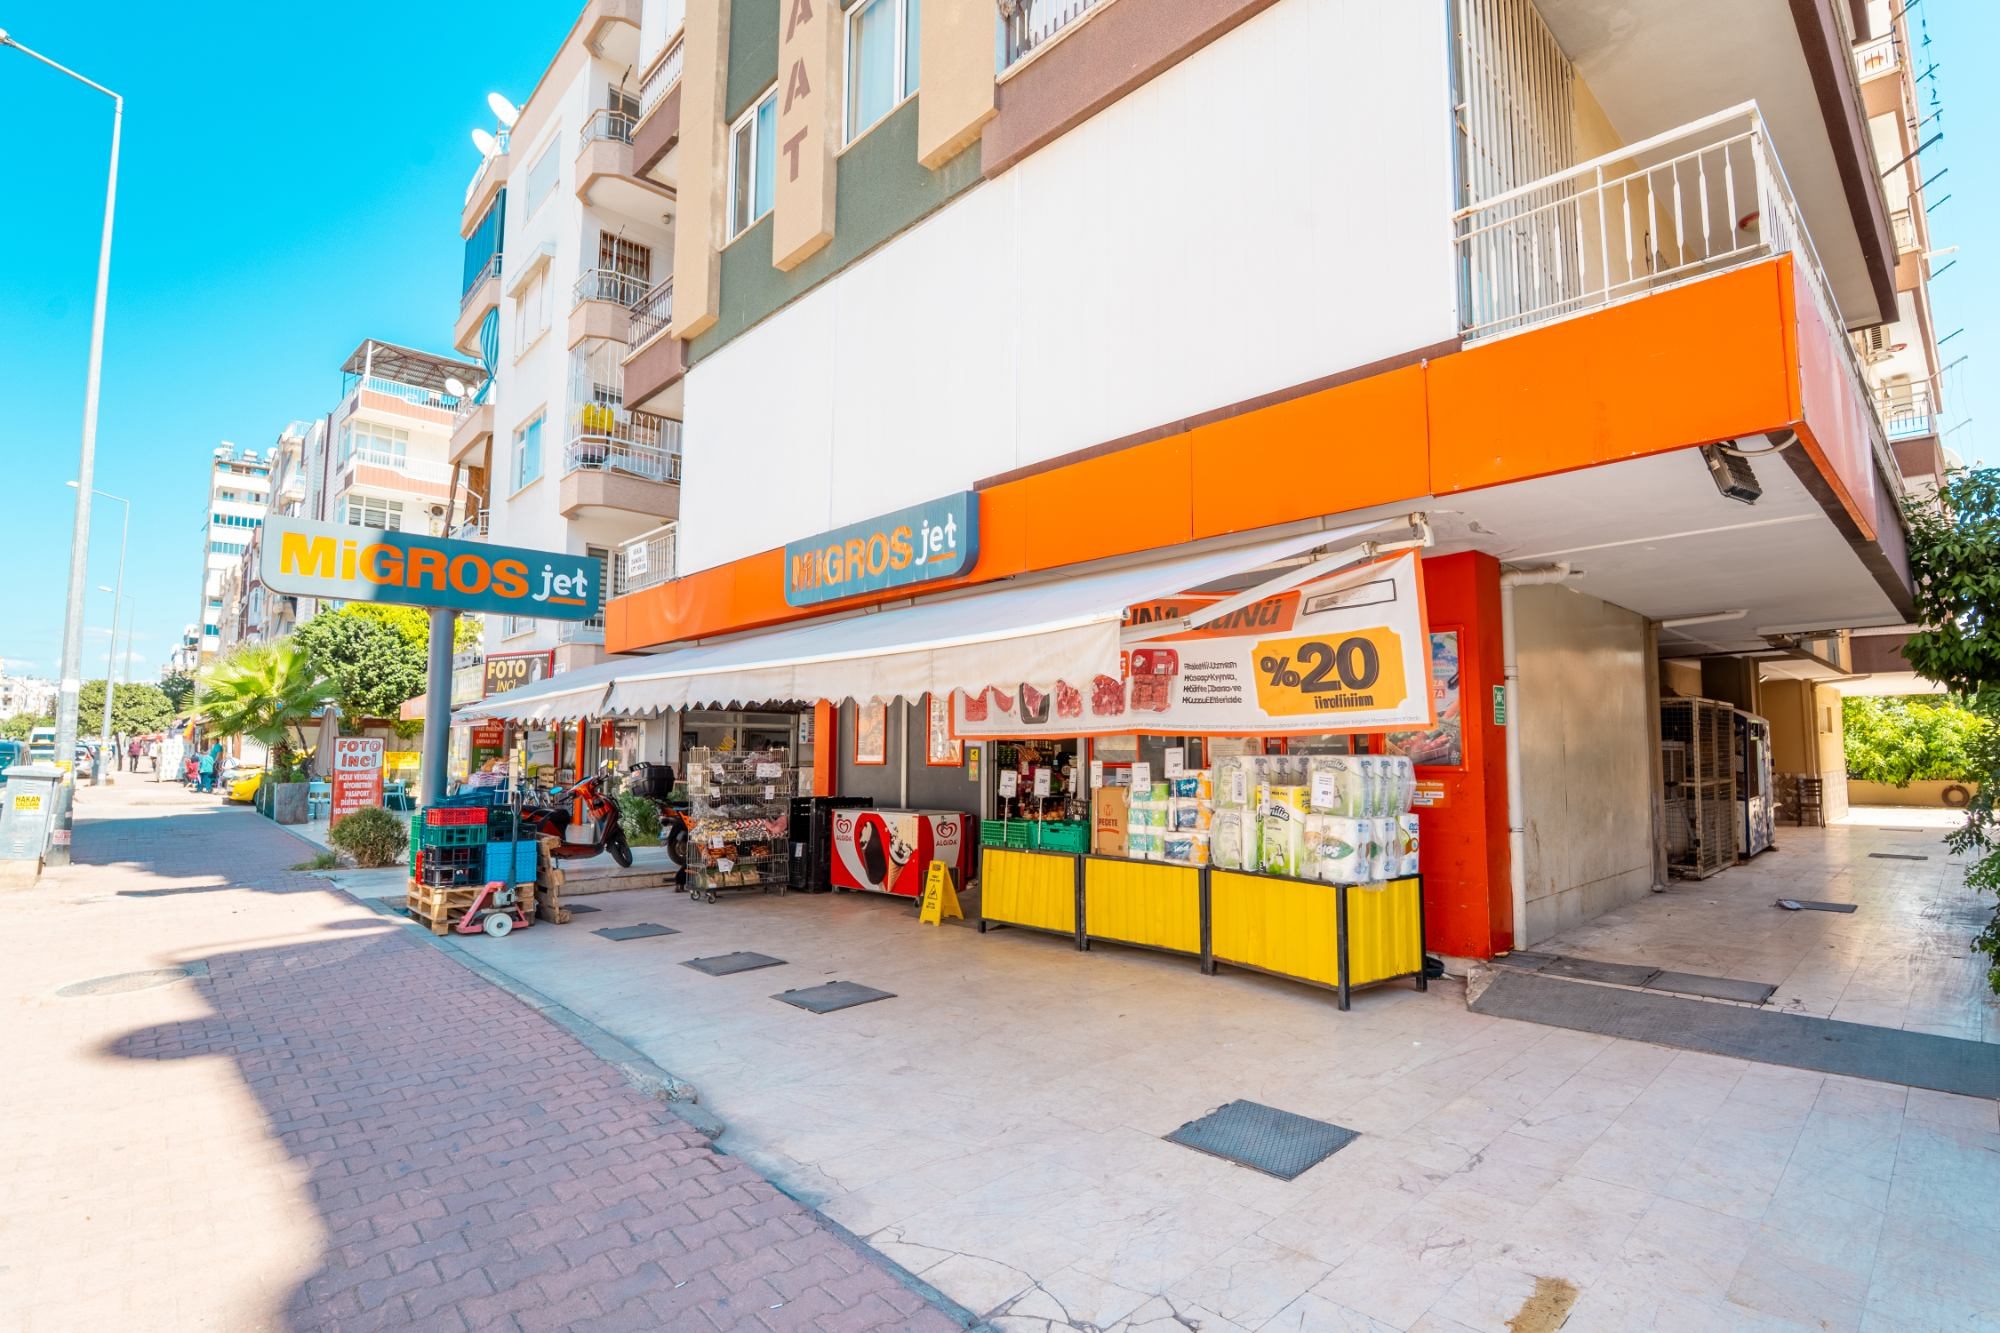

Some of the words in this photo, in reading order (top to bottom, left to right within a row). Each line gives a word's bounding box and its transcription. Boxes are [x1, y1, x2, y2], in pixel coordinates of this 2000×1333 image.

[915, 512, 957, 566] jet
[532, 564, 588, 601] jet
[487, 659, 527, 679] FOTO
[1260, 637, 1380, 693] %20
[338, 740, 382, 752] FOTO
[15, 795, 41, 803] HAKAN
